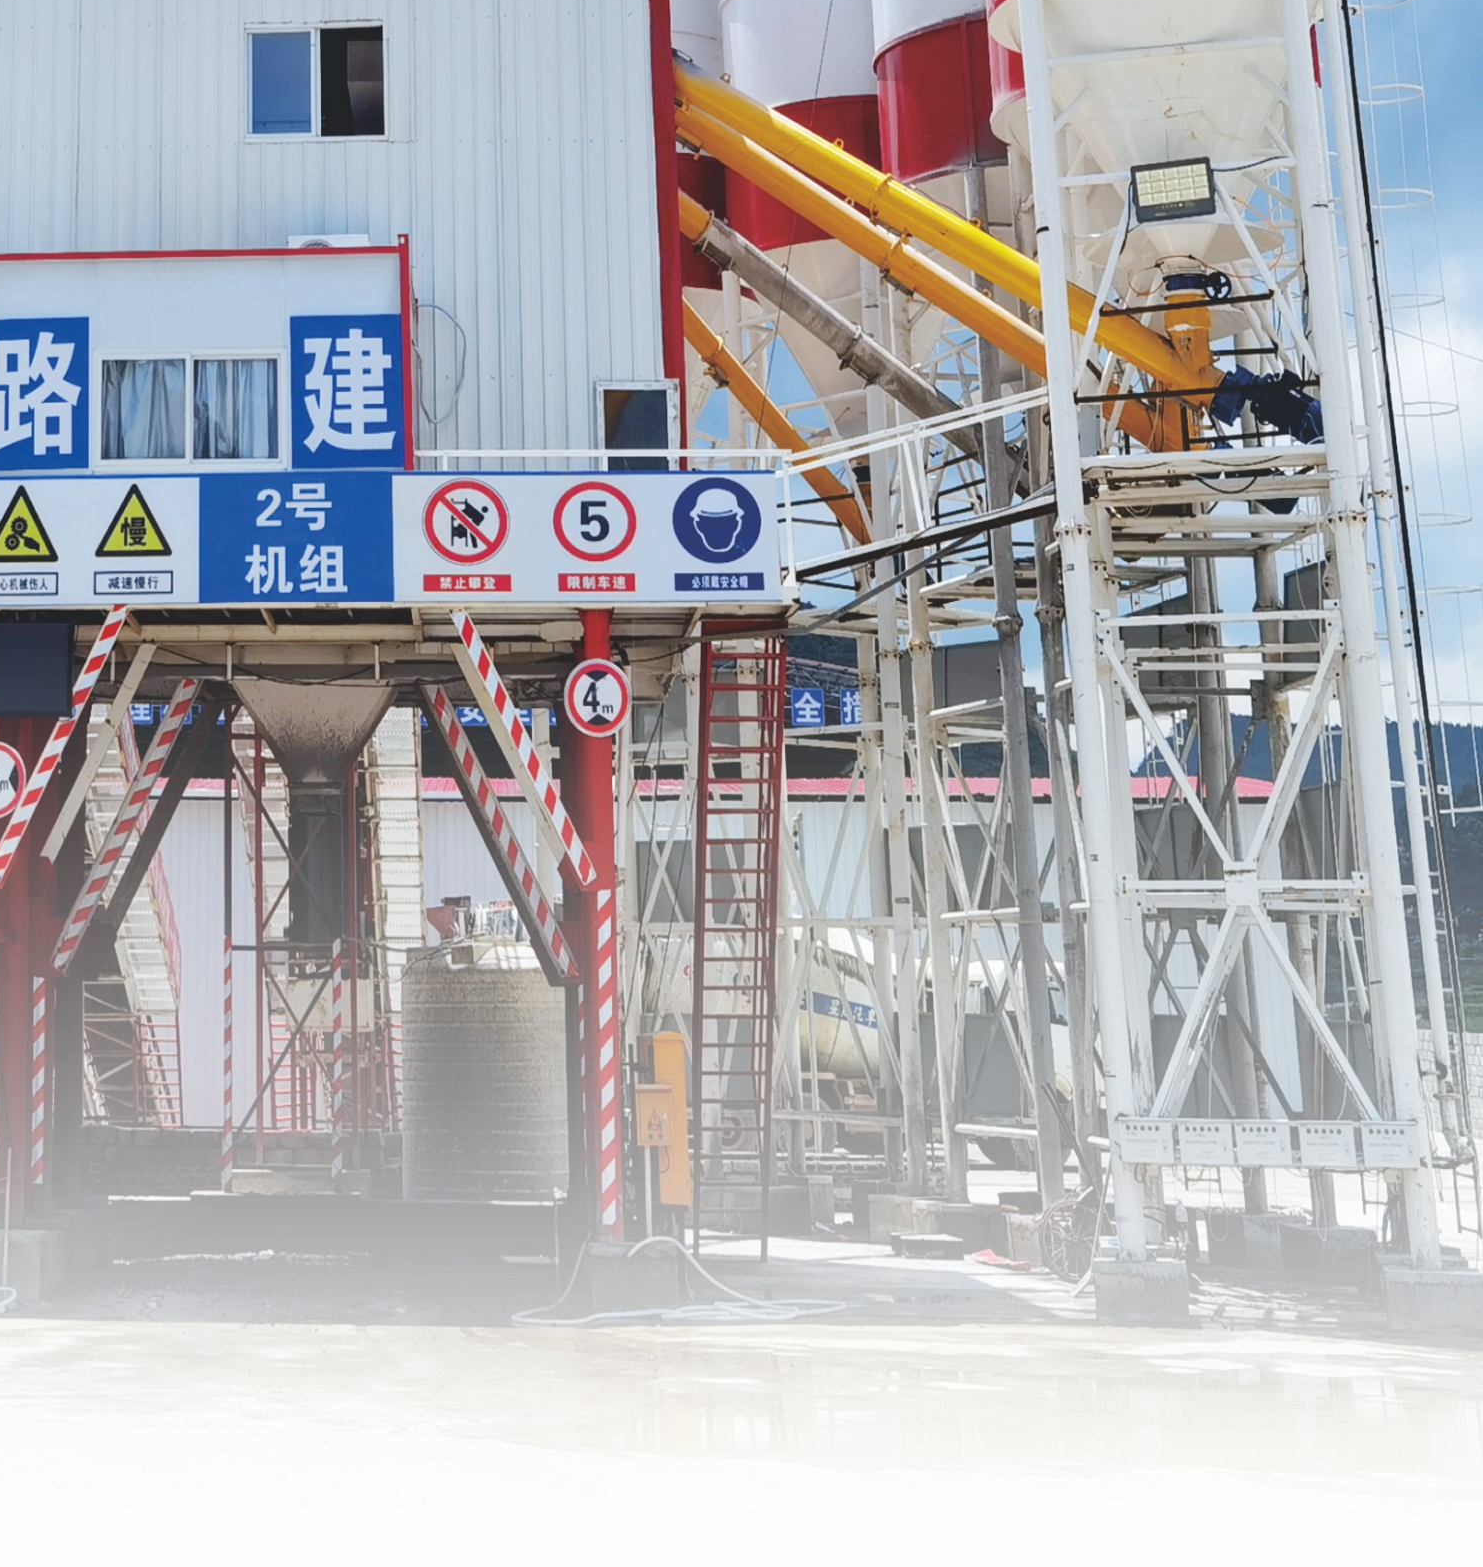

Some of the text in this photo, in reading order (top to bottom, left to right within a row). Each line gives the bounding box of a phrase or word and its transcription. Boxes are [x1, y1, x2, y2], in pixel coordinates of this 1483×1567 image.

[256, 482, 333, 531] 2号
[579, 499, 611, 543] 5
[120, 515, 148, 548] 慢
[108, 576, 160, 591] 减速慢行
[245, 543, 348, 595] 机组
[566, 575, 627, 591] 限制车速
[691, 575, 749, 590] 必须戴安全帽
[582, 681, 614, 714] 4m
[829, 999, 876, 1026] 星汽车
